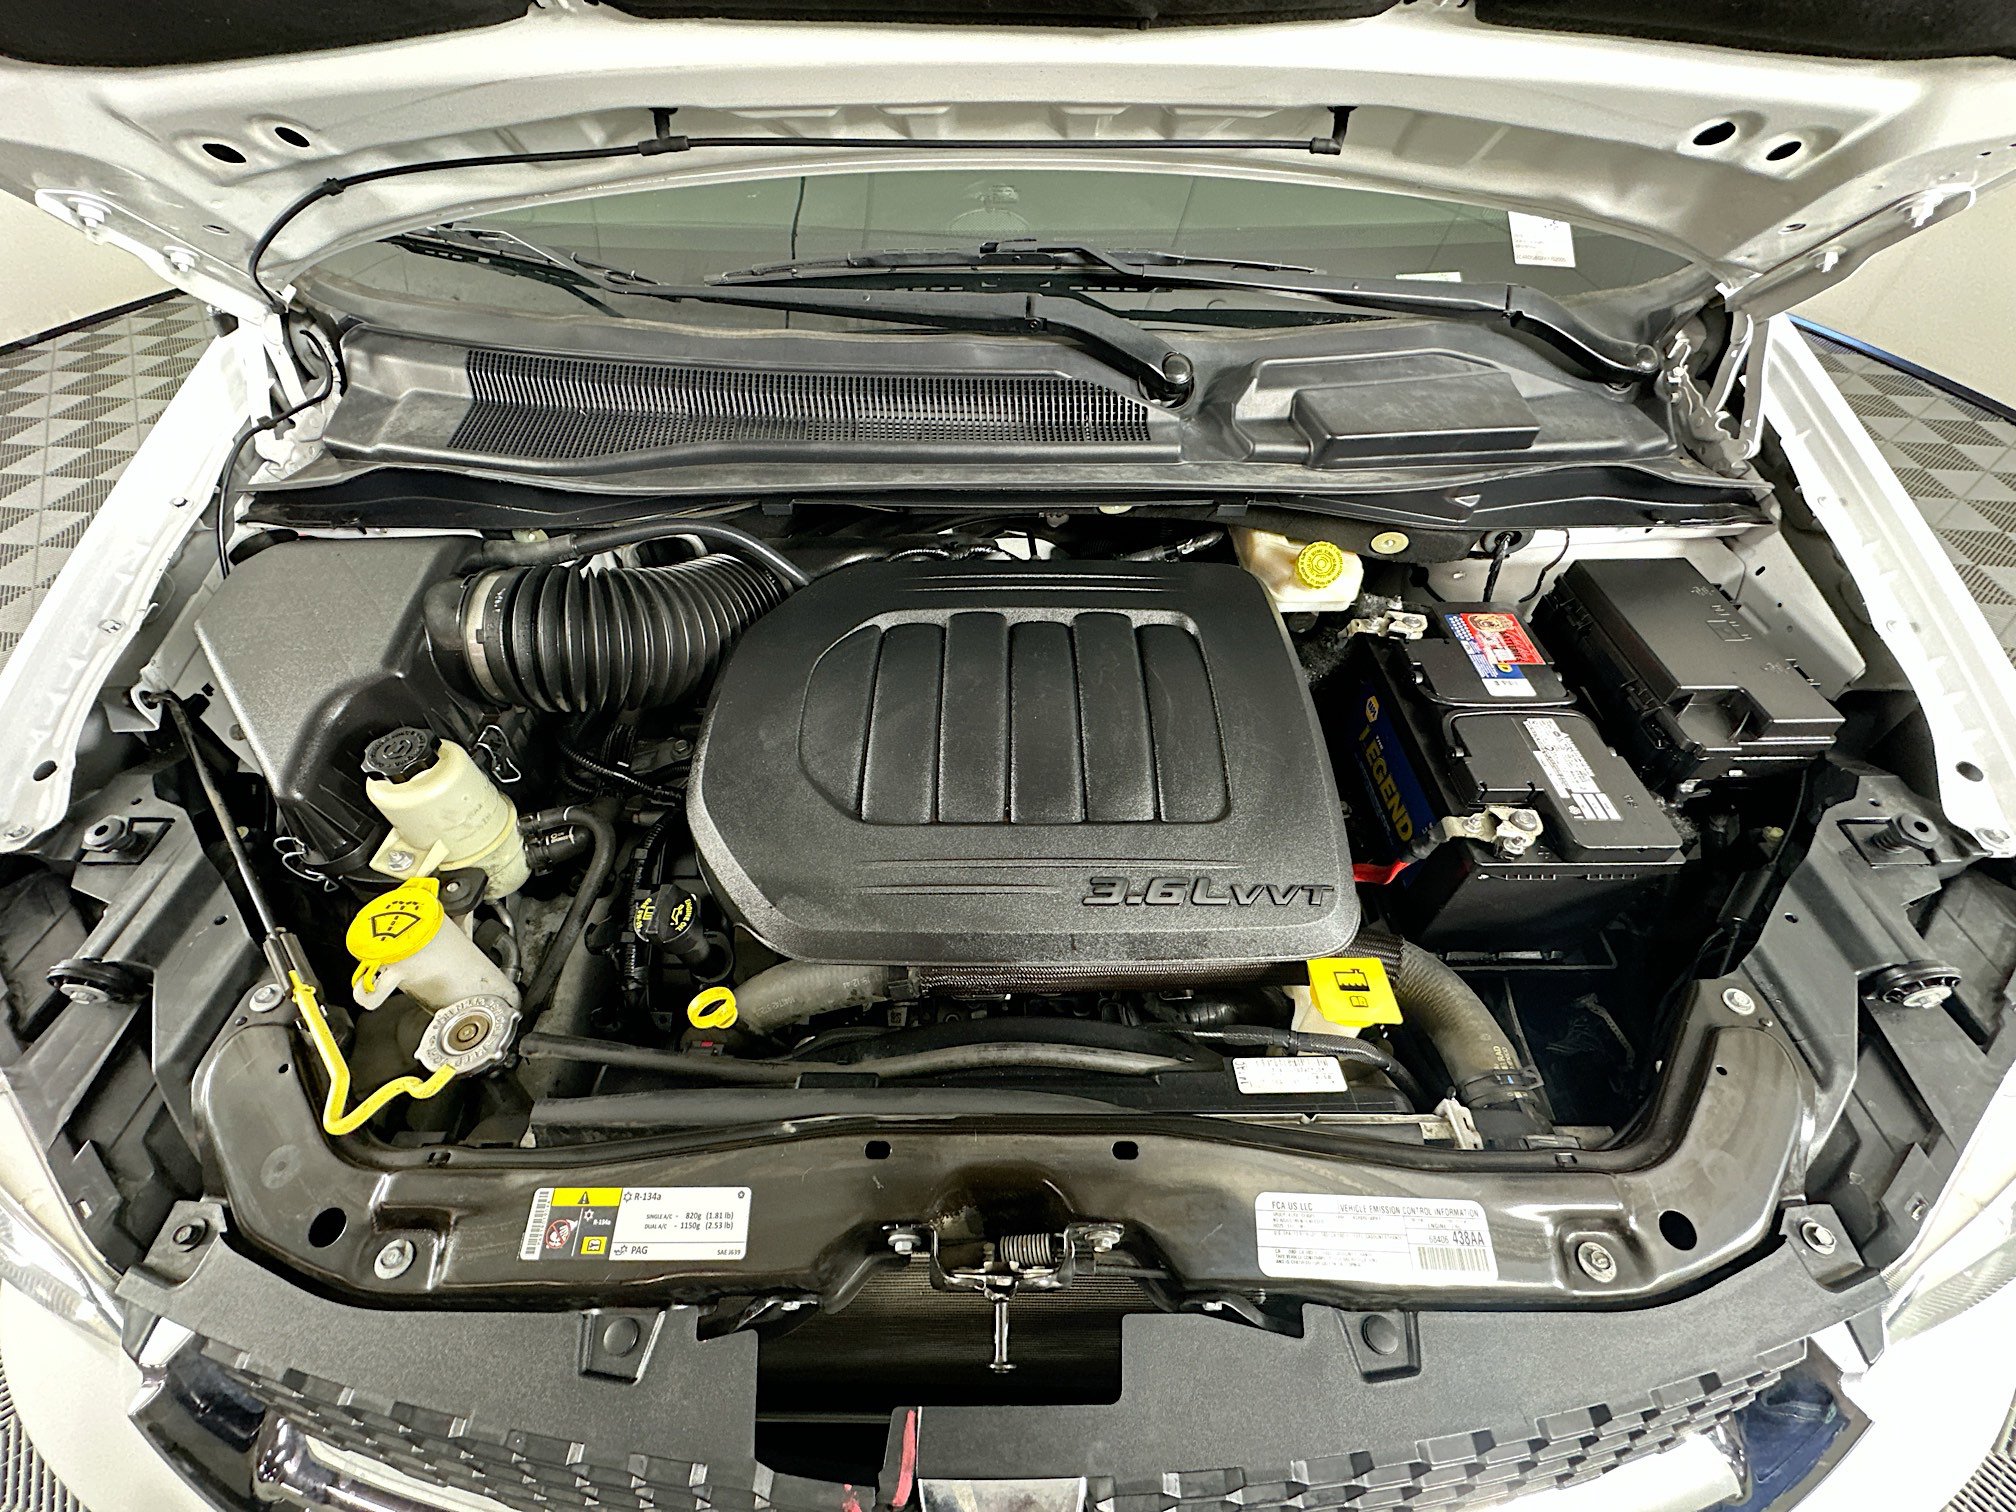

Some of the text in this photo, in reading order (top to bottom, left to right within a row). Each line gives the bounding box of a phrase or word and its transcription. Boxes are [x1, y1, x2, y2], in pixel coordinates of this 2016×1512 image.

[674, 898, 693, 932] ENGINE OIL
[634, 1191, 662, 1201] R-134a
[1271, 1201, 1313, 1211] FCA US LLC
[1339, 1204, 1479, 1218] VEHICLE EMISSION CONTROL INFORMATION
[685, 1212, 702, 1221] 820g
[705, 1211, 723, 1221] (1.81
[724, 1211, 734, 1221] lb)
[680, 1222, 701, 1231] 1150g
[705, 1221, 723, 1231] (2.53
[724, 1221, 734, 1231] lb)
[1452, 1230, 1485, 1246] 438AA
[631, 1245, 648, 1255] PAG
